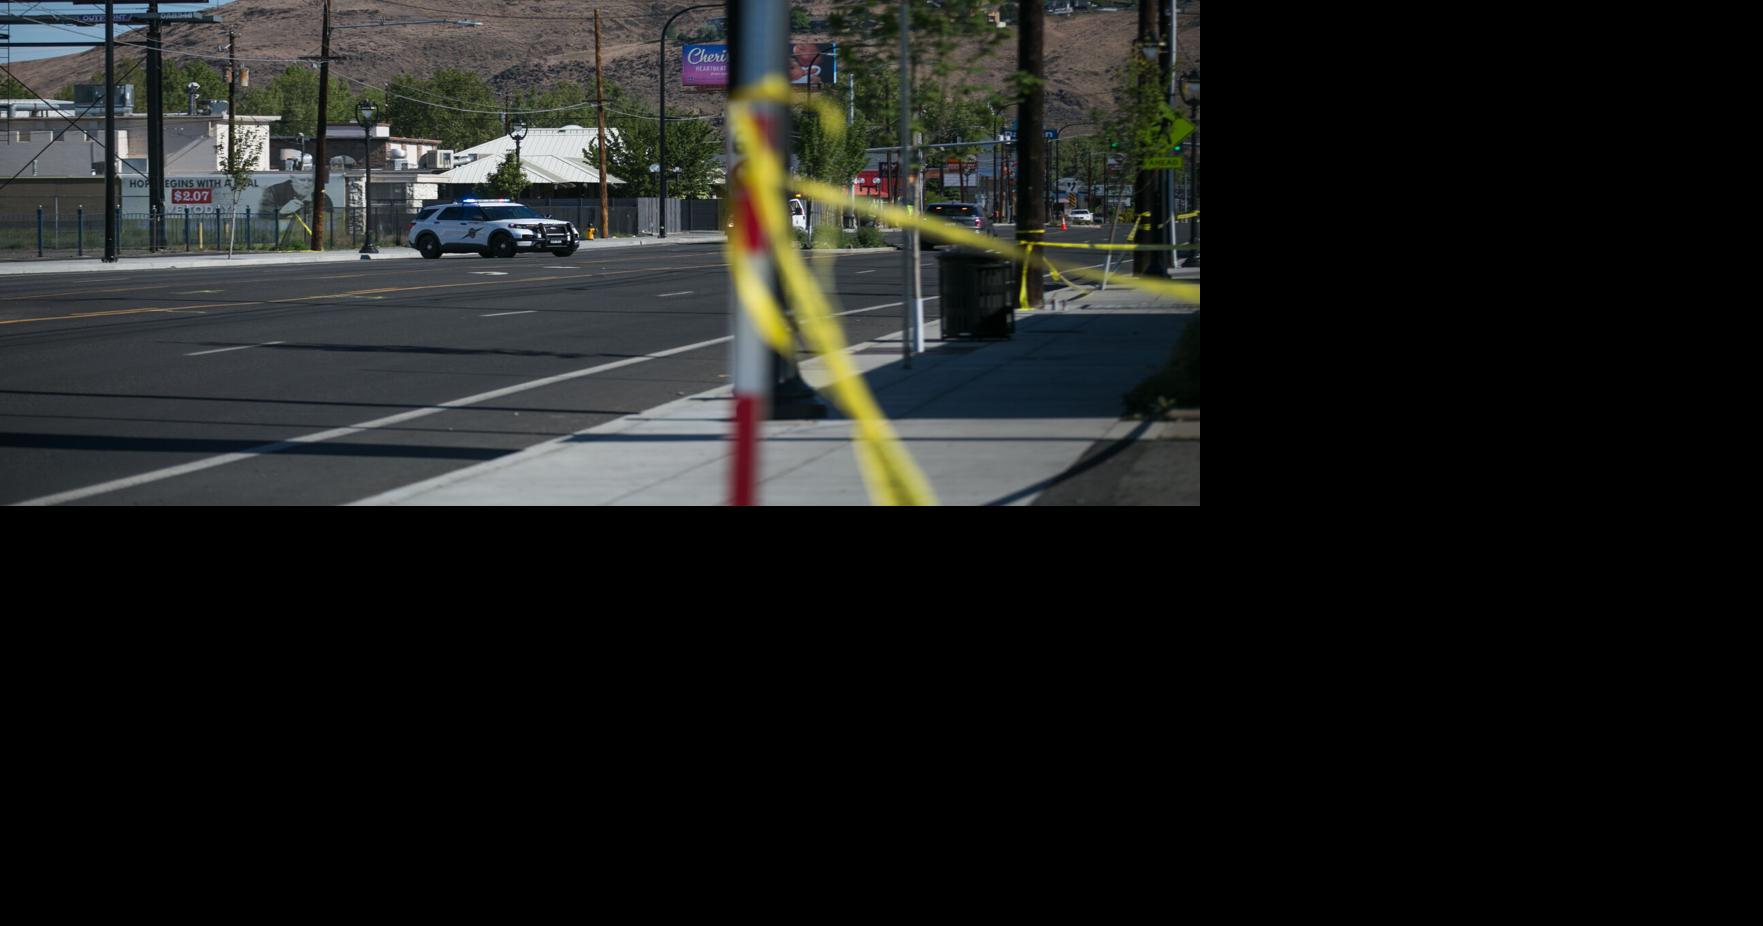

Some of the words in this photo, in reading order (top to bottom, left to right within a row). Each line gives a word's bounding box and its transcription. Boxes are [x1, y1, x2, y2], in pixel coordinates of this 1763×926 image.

[687, 47, 729, 65] Cheri
[129, 179, 150, 188] HOP
[165, 179, 194, 188] EGINS
[197, 179, 221, 188] WITH
[174, 190, 209, 202] $2.07
